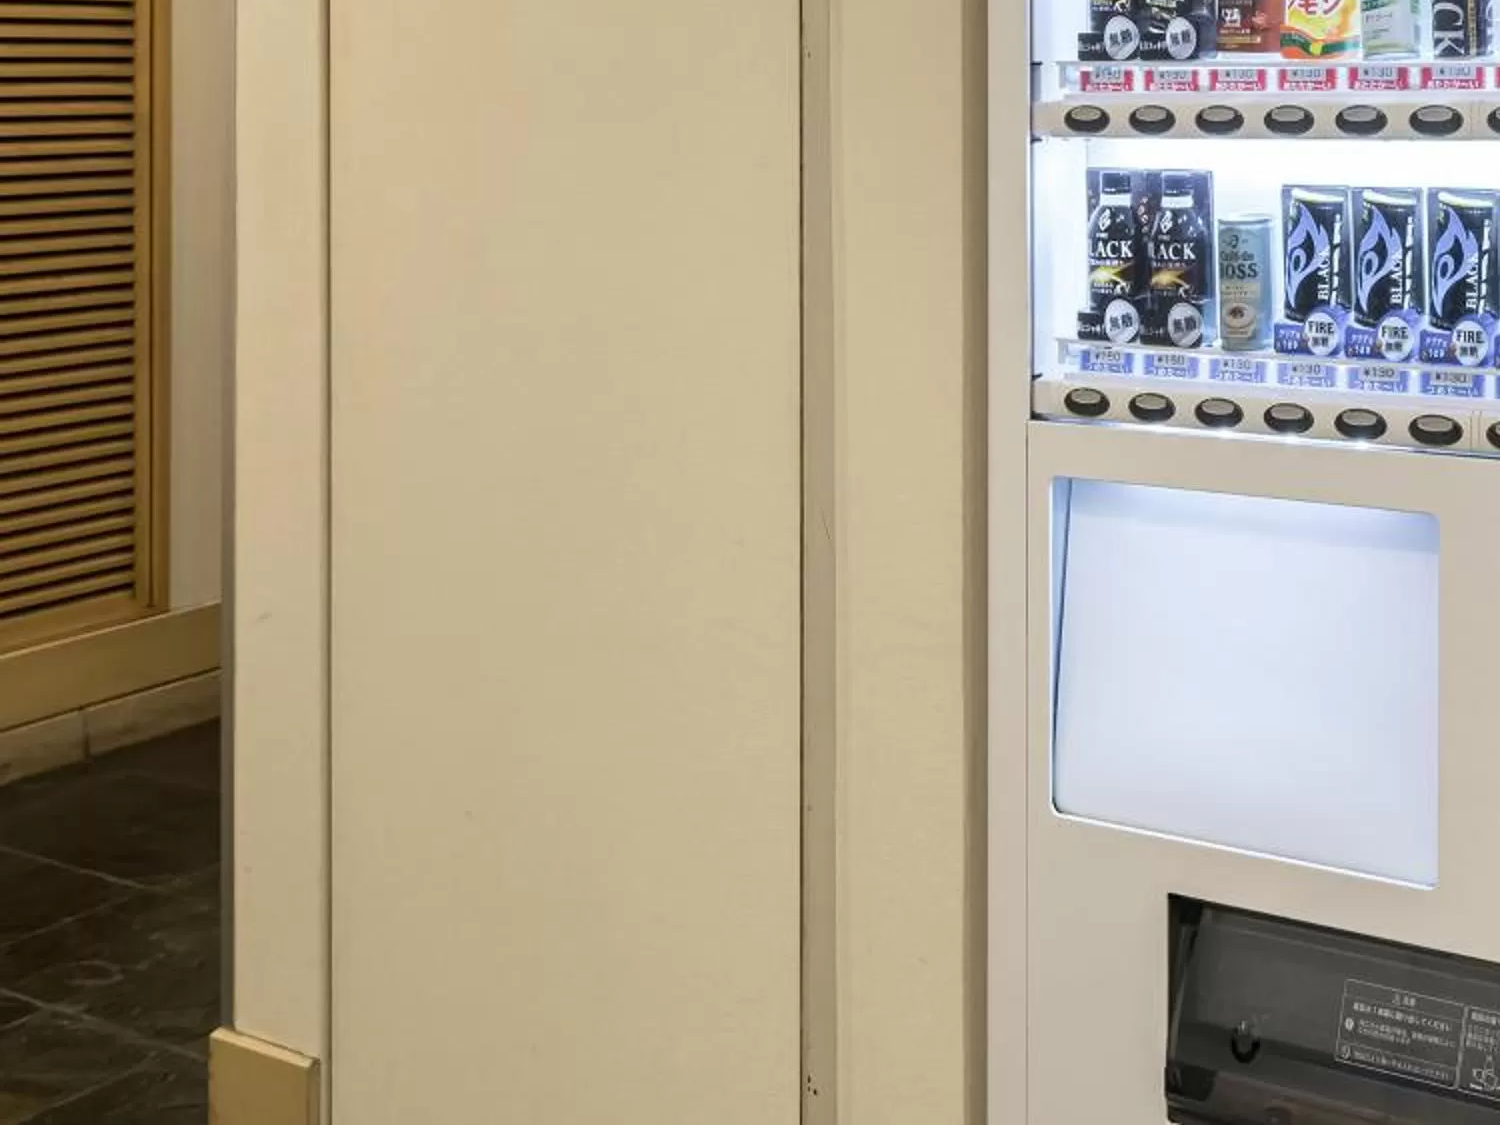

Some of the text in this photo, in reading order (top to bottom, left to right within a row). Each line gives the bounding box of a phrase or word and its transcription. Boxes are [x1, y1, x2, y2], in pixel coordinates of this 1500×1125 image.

[1308, 321, 1335, 335] FIRE
[1381, 324, 1409, 339] FIRE
[1456, 330, 1484, 344] FIRE
